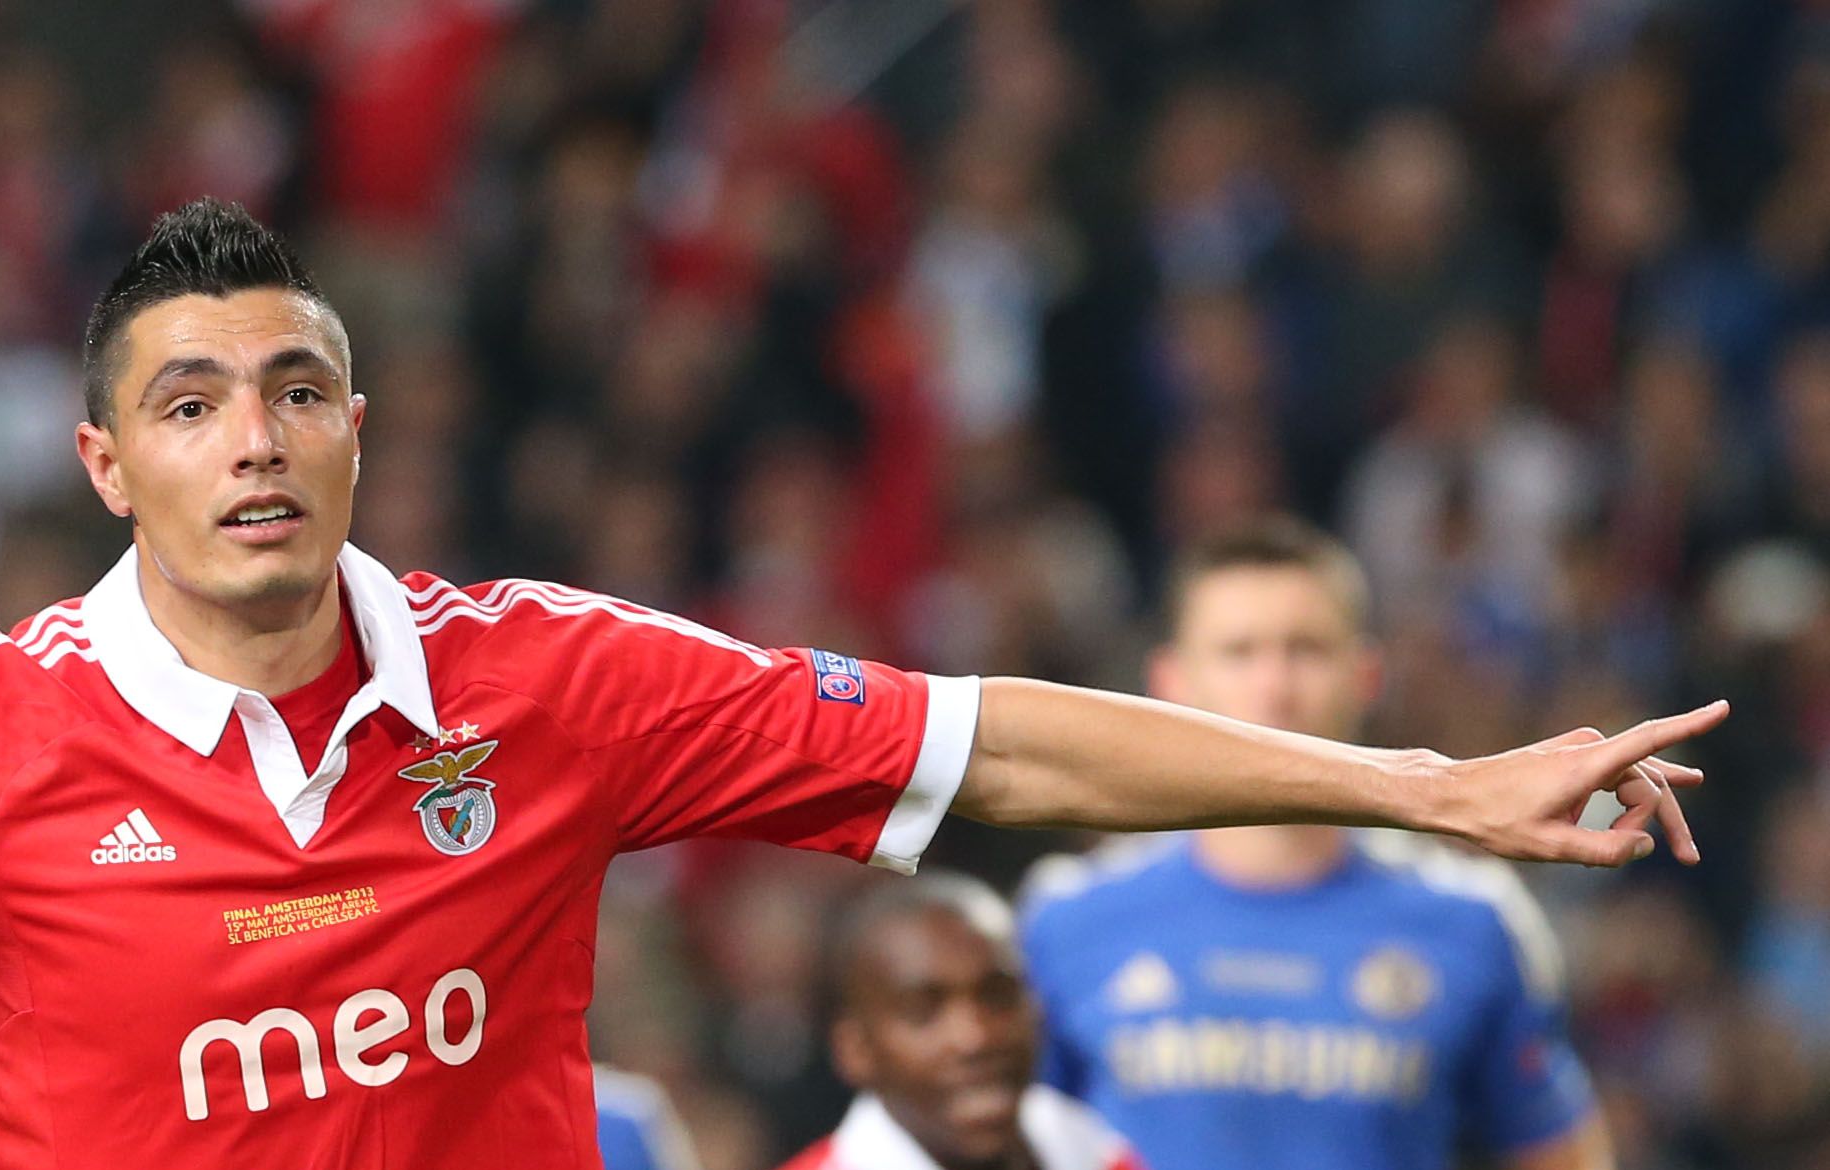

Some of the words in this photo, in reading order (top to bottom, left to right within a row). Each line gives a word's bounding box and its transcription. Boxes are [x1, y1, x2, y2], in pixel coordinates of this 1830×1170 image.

[90, 842, 176, 865] adidas
[223, 906, 260, 922] FINAL
[264, 892, 343, 916] AMSTERDAM
[344, 886, 375, 901] 2013
[246, 917, 270, 930] MAY
[272, 904, 339, 925] AMSTERDAM
[341, 897, 377, 911] ARENA
[228, 933, 242, 945] SL
[244, 924, 296, 942] BENFICA
[297, 922, 310, 932] vs
[311, 910, 364, 929] CHELSEA
[365, 904, 381, 915] FC
[178, 968, 488, 1121] meo
